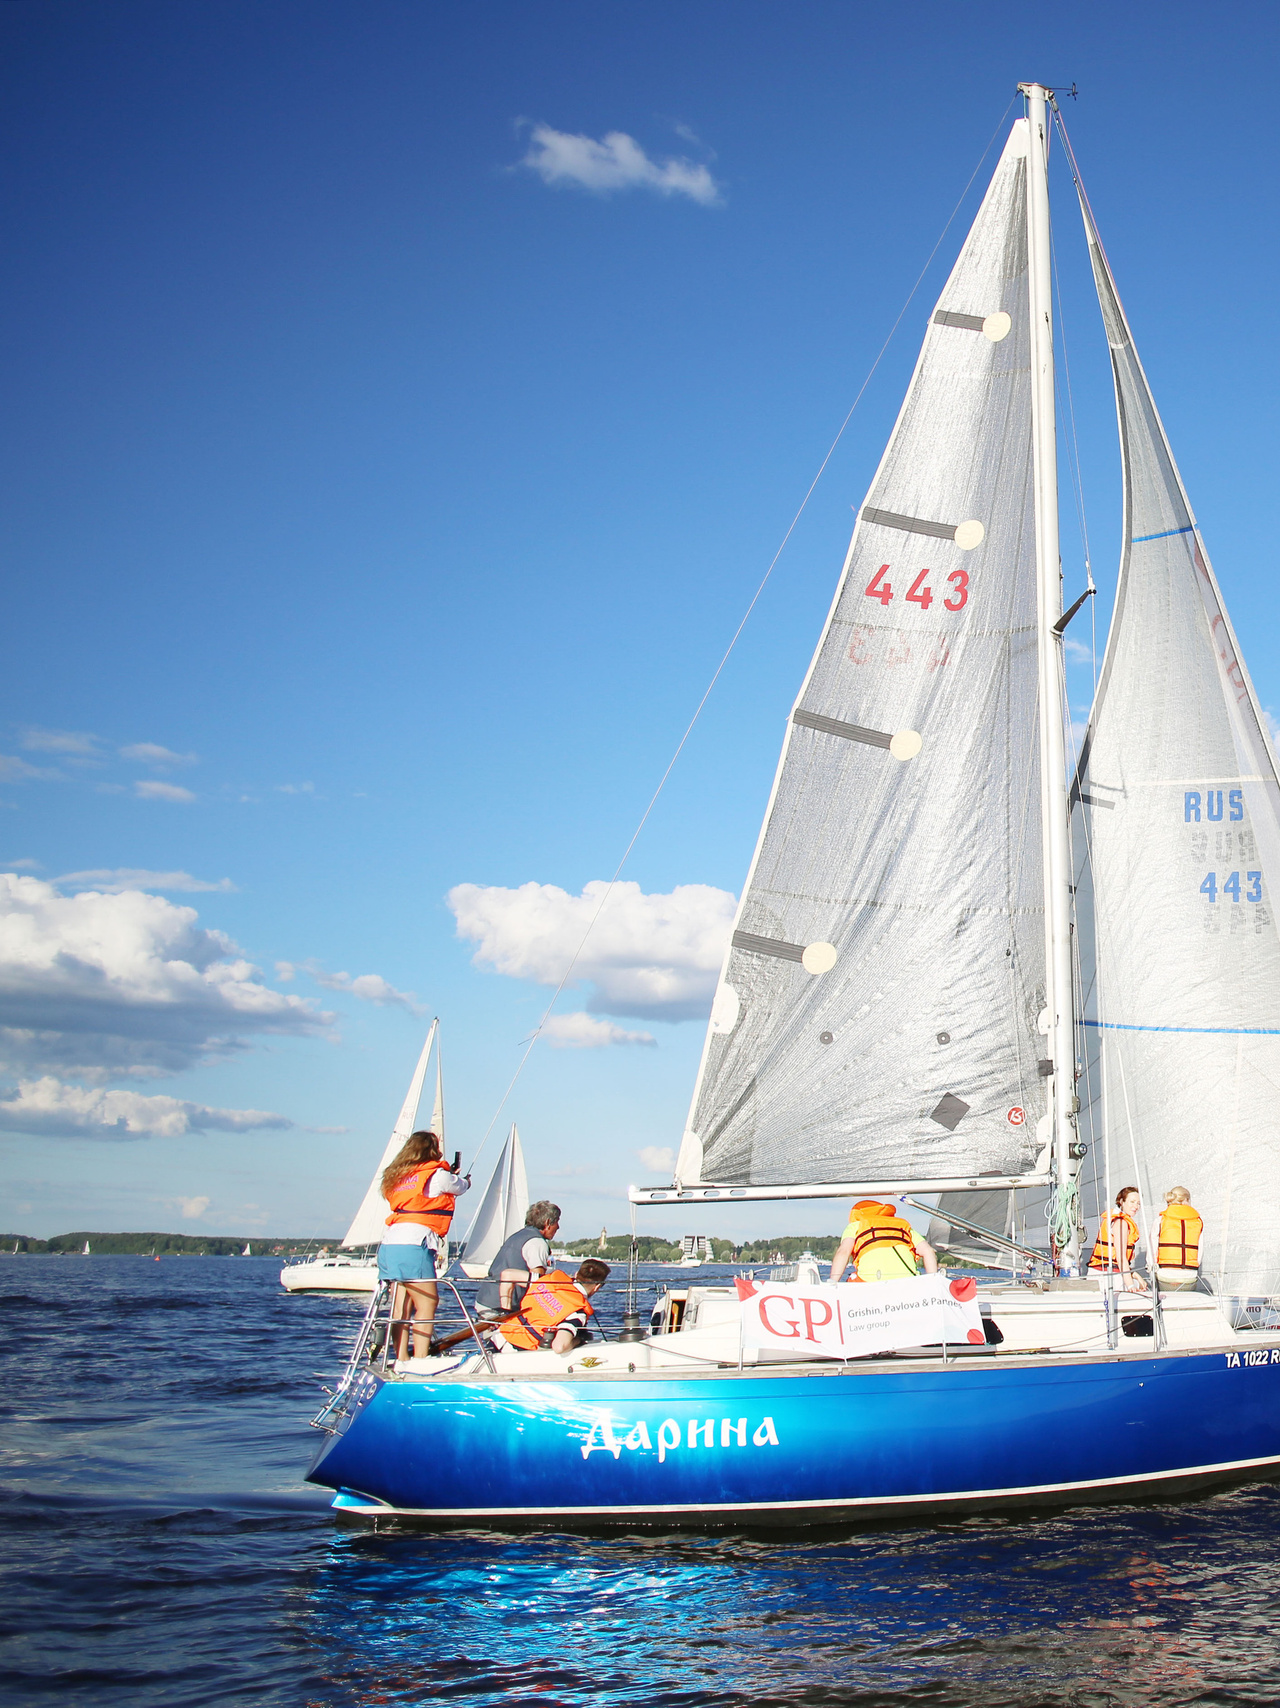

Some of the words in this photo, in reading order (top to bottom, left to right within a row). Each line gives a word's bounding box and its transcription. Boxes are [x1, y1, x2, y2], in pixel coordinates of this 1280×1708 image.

[865, 564, 969, 611] 443
[1184, 789, 1244, 822] RUS
[1200, 871, 1262, 903] 443
[536, 1282, 564, 1313] DARINA
[847, 1307, 883, 1319] Grishin,
[885, 1300, 920, 1313] Pavlova
[758, 1294, 833, 1343] GP
[849, 1323, 866, 1332] Law
[866, 1320, 891, 1329] group
[1224, 1352, 1241, 1368] TA
[1243, 1350, 1269, 1366] 1022
[580, 1407, 780, 1463] Дарина
